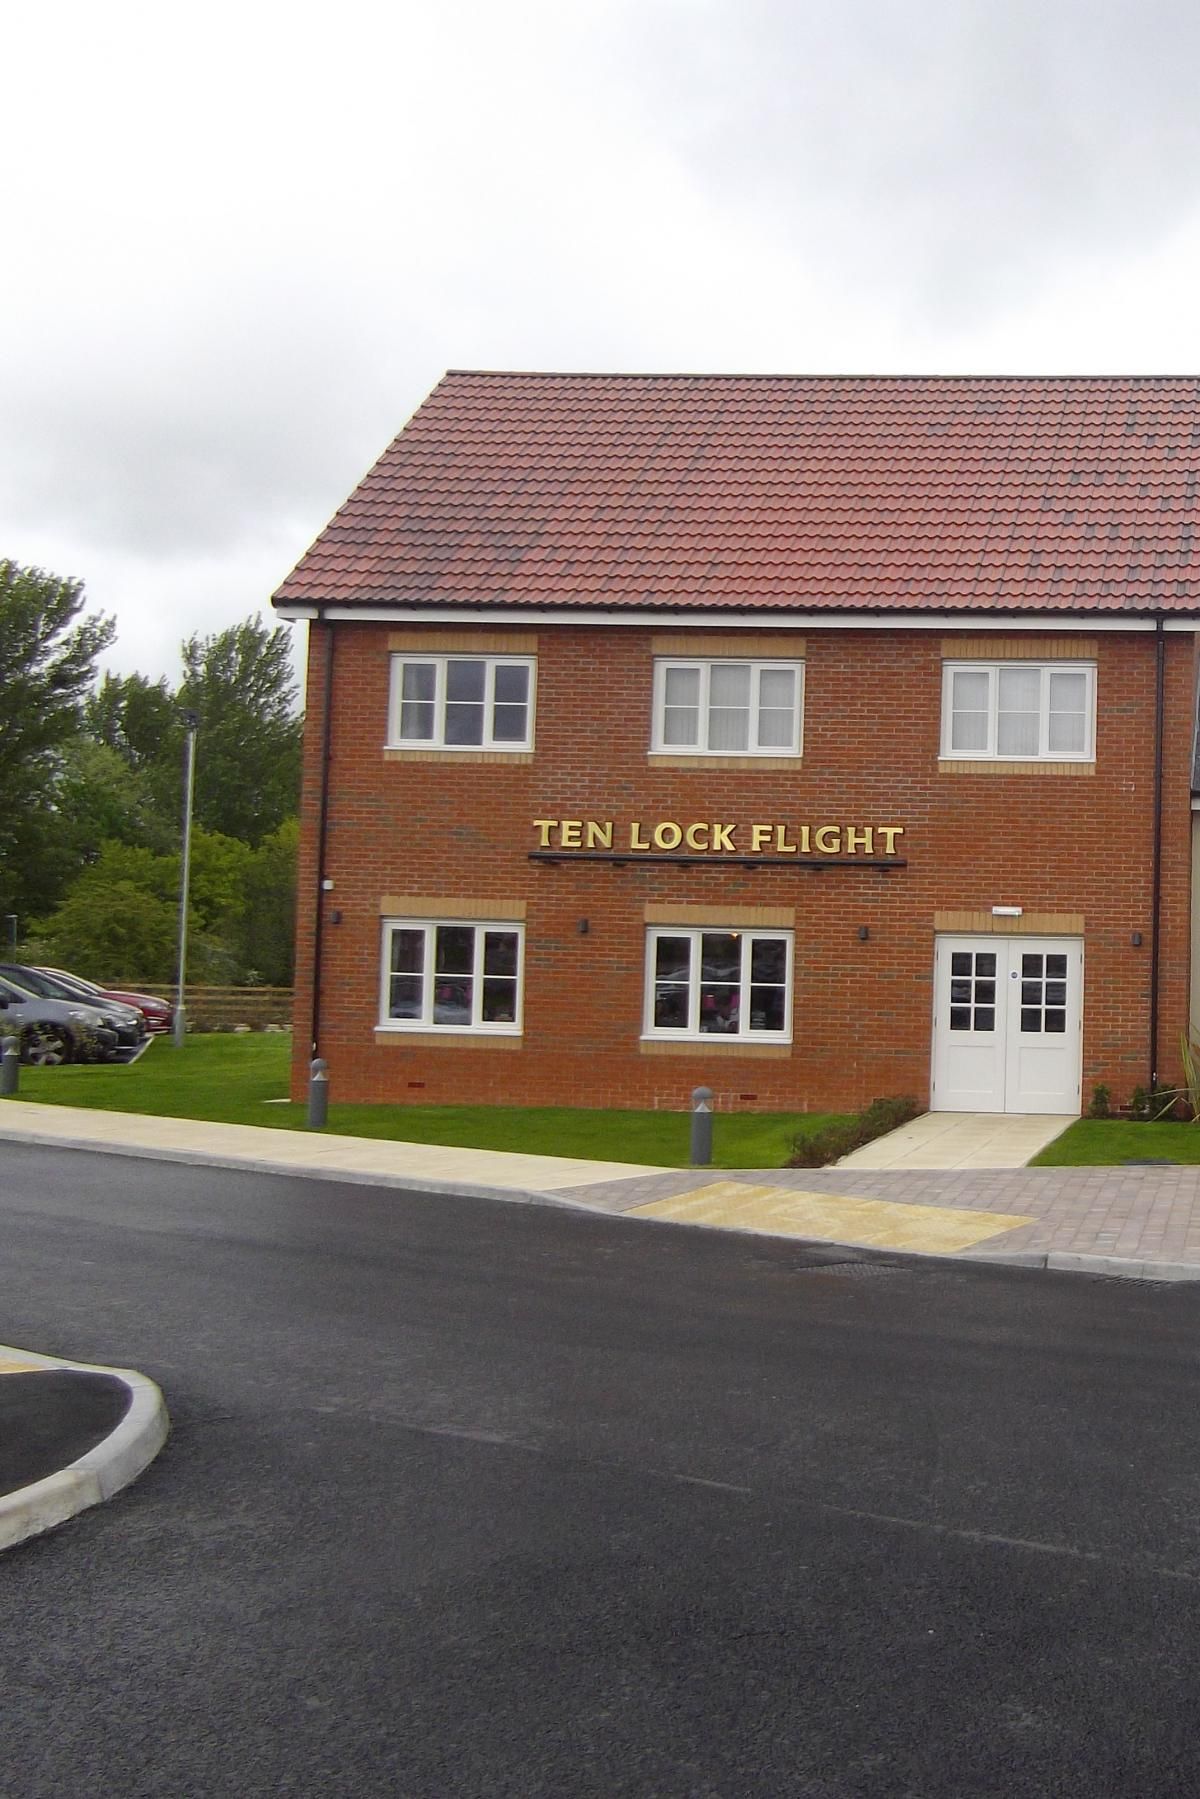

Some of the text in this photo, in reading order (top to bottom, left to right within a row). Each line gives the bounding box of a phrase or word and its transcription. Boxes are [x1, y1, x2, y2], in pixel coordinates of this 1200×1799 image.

[533, 819, 904, 855] TEN LOCK FLIGHT
